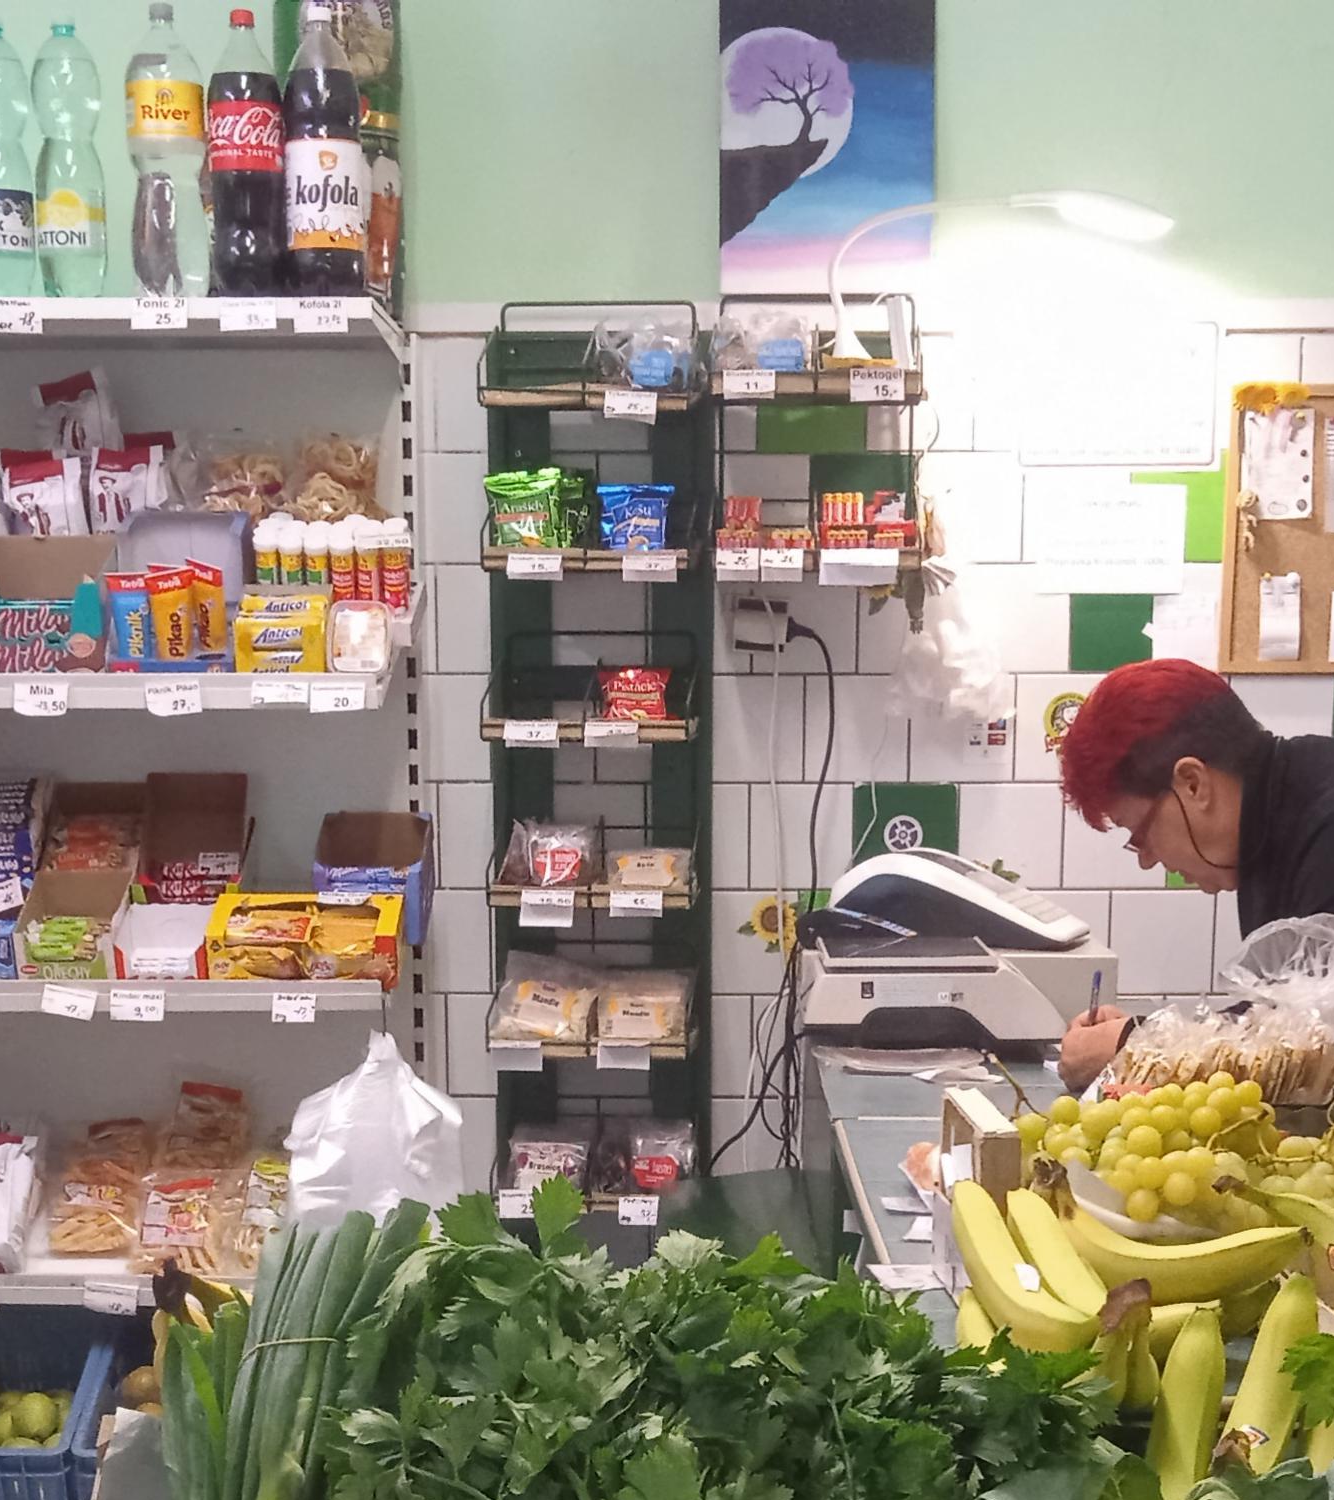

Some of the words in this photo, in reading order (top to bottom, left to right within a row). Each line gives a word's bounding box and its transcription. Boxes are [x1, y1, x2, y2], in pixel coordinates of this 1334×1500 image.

[141, 103, 191, 122] River
[295, 175, 359, 213] kofola
[136, 299, 169, 310] Tonic
[299, 300, 332, 310] Kofola
[852, 369, 903, 382] Pektogel
[624, 505, 652, 518] Kešu
[264, 599, 309, 613] Anticol
[128, 609, 146, 658] Piknik
[168, 612, 185, 658] Pikao
[253, 626, 304, 644] Anticol
[29, 685, 55, 696] Mila
